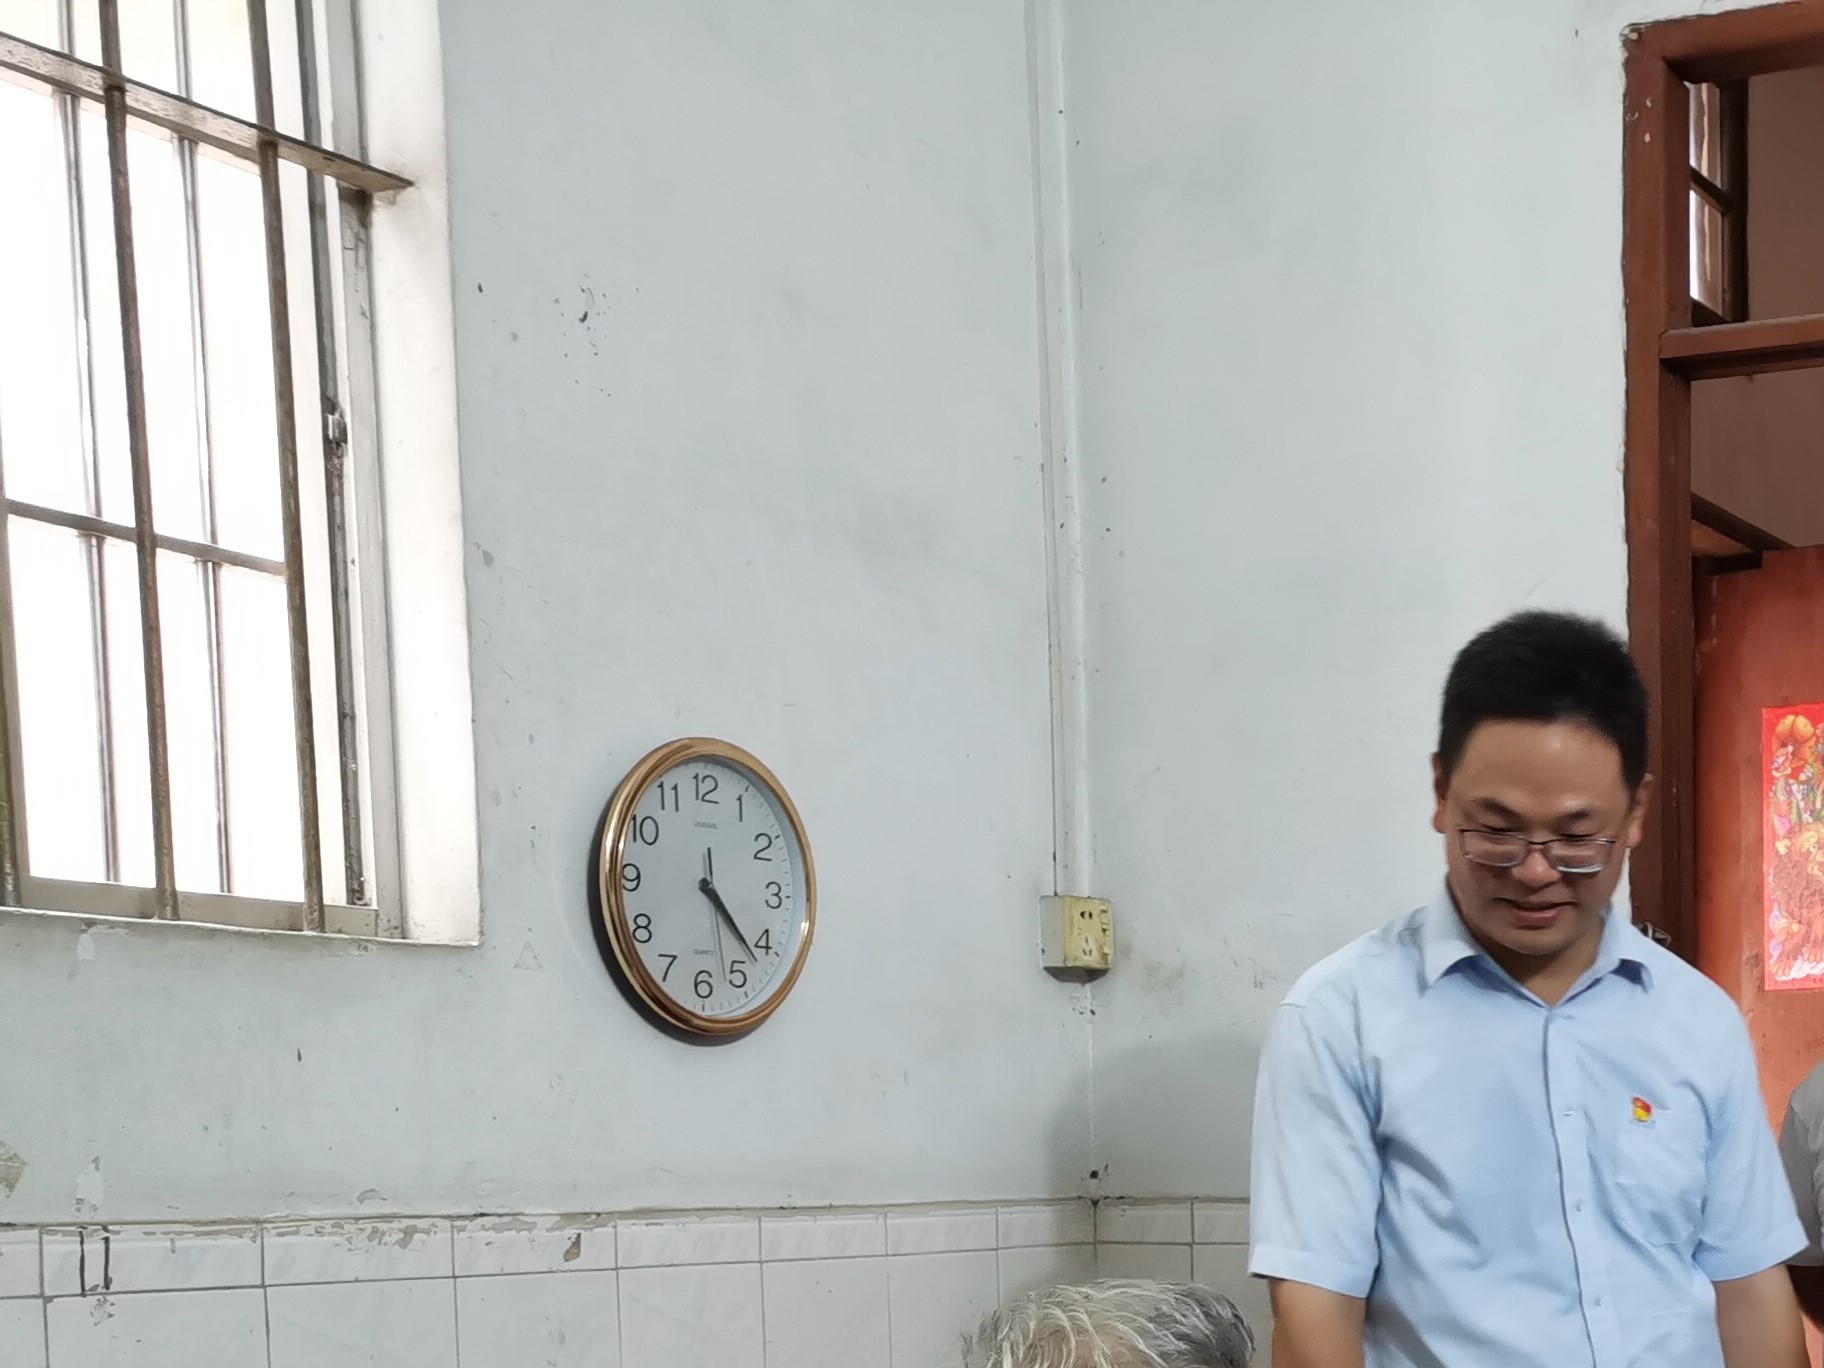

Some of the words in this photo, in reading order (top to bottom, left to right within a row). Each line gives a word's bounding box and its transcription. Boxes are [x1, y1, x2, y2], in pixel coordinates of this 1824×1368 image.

[657, 781, 680, 812] 11
[692, 773, 720, 804] 12
[735, 794, 743, 822] 1
[630, 813, 660, 845] 10
[753, 832, 773, 862] 2
[621, 863, 642, 892] 9
[764, 881, 783, 909] 3
[632, 913, 653, 943] 8
[753, 928, 773, 956] 4
[657, 954, 679, 983] 7
[728, 960, 748, 989] 5
[693, 969, 713, 999] 6
